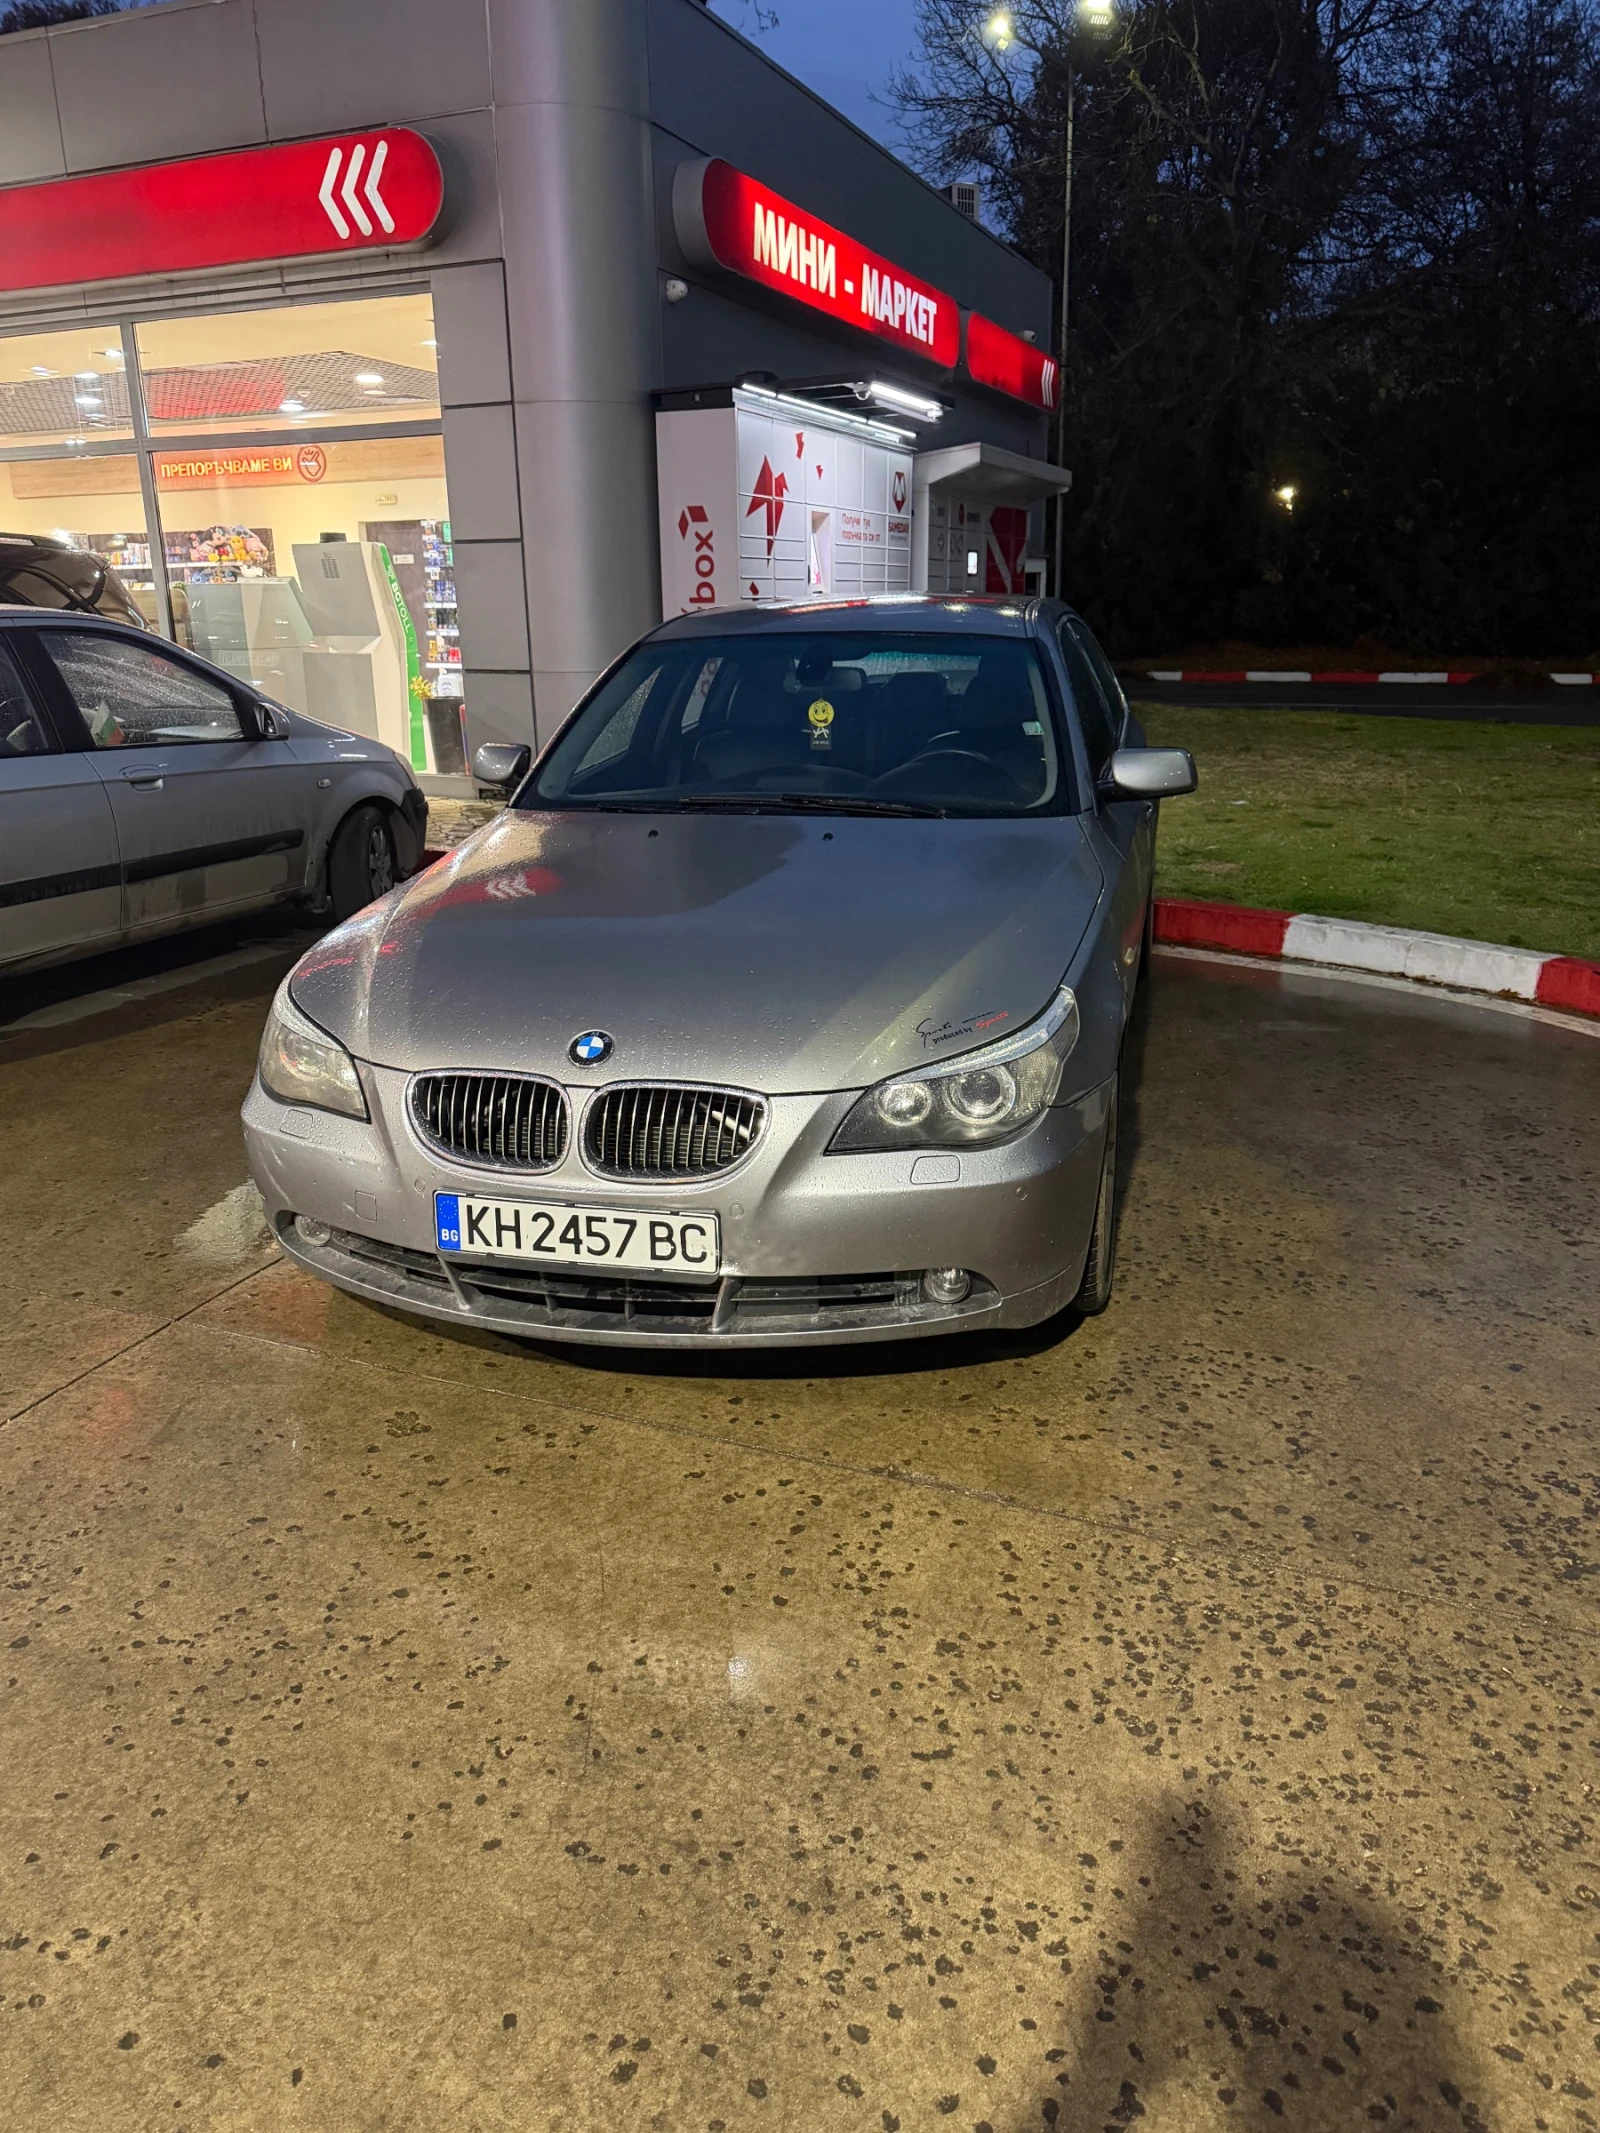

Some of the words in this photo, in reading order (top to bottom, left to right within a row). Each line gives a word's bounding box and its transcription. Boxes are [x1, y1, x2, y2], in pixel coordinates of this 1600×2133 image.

[753, 202, 836, 298] МИНИ
[861, 263, 937, 345] МАРКЕТ
[161, 458, 270, 477] ПРЕПОРЪЧВАМЕ
[273, 457, 292, 471] ВИ
[932, 1030, 962, 1044] produced
[441, 1228, 458, 1241] BG
[531, 1211, 637, 1258] 2457
